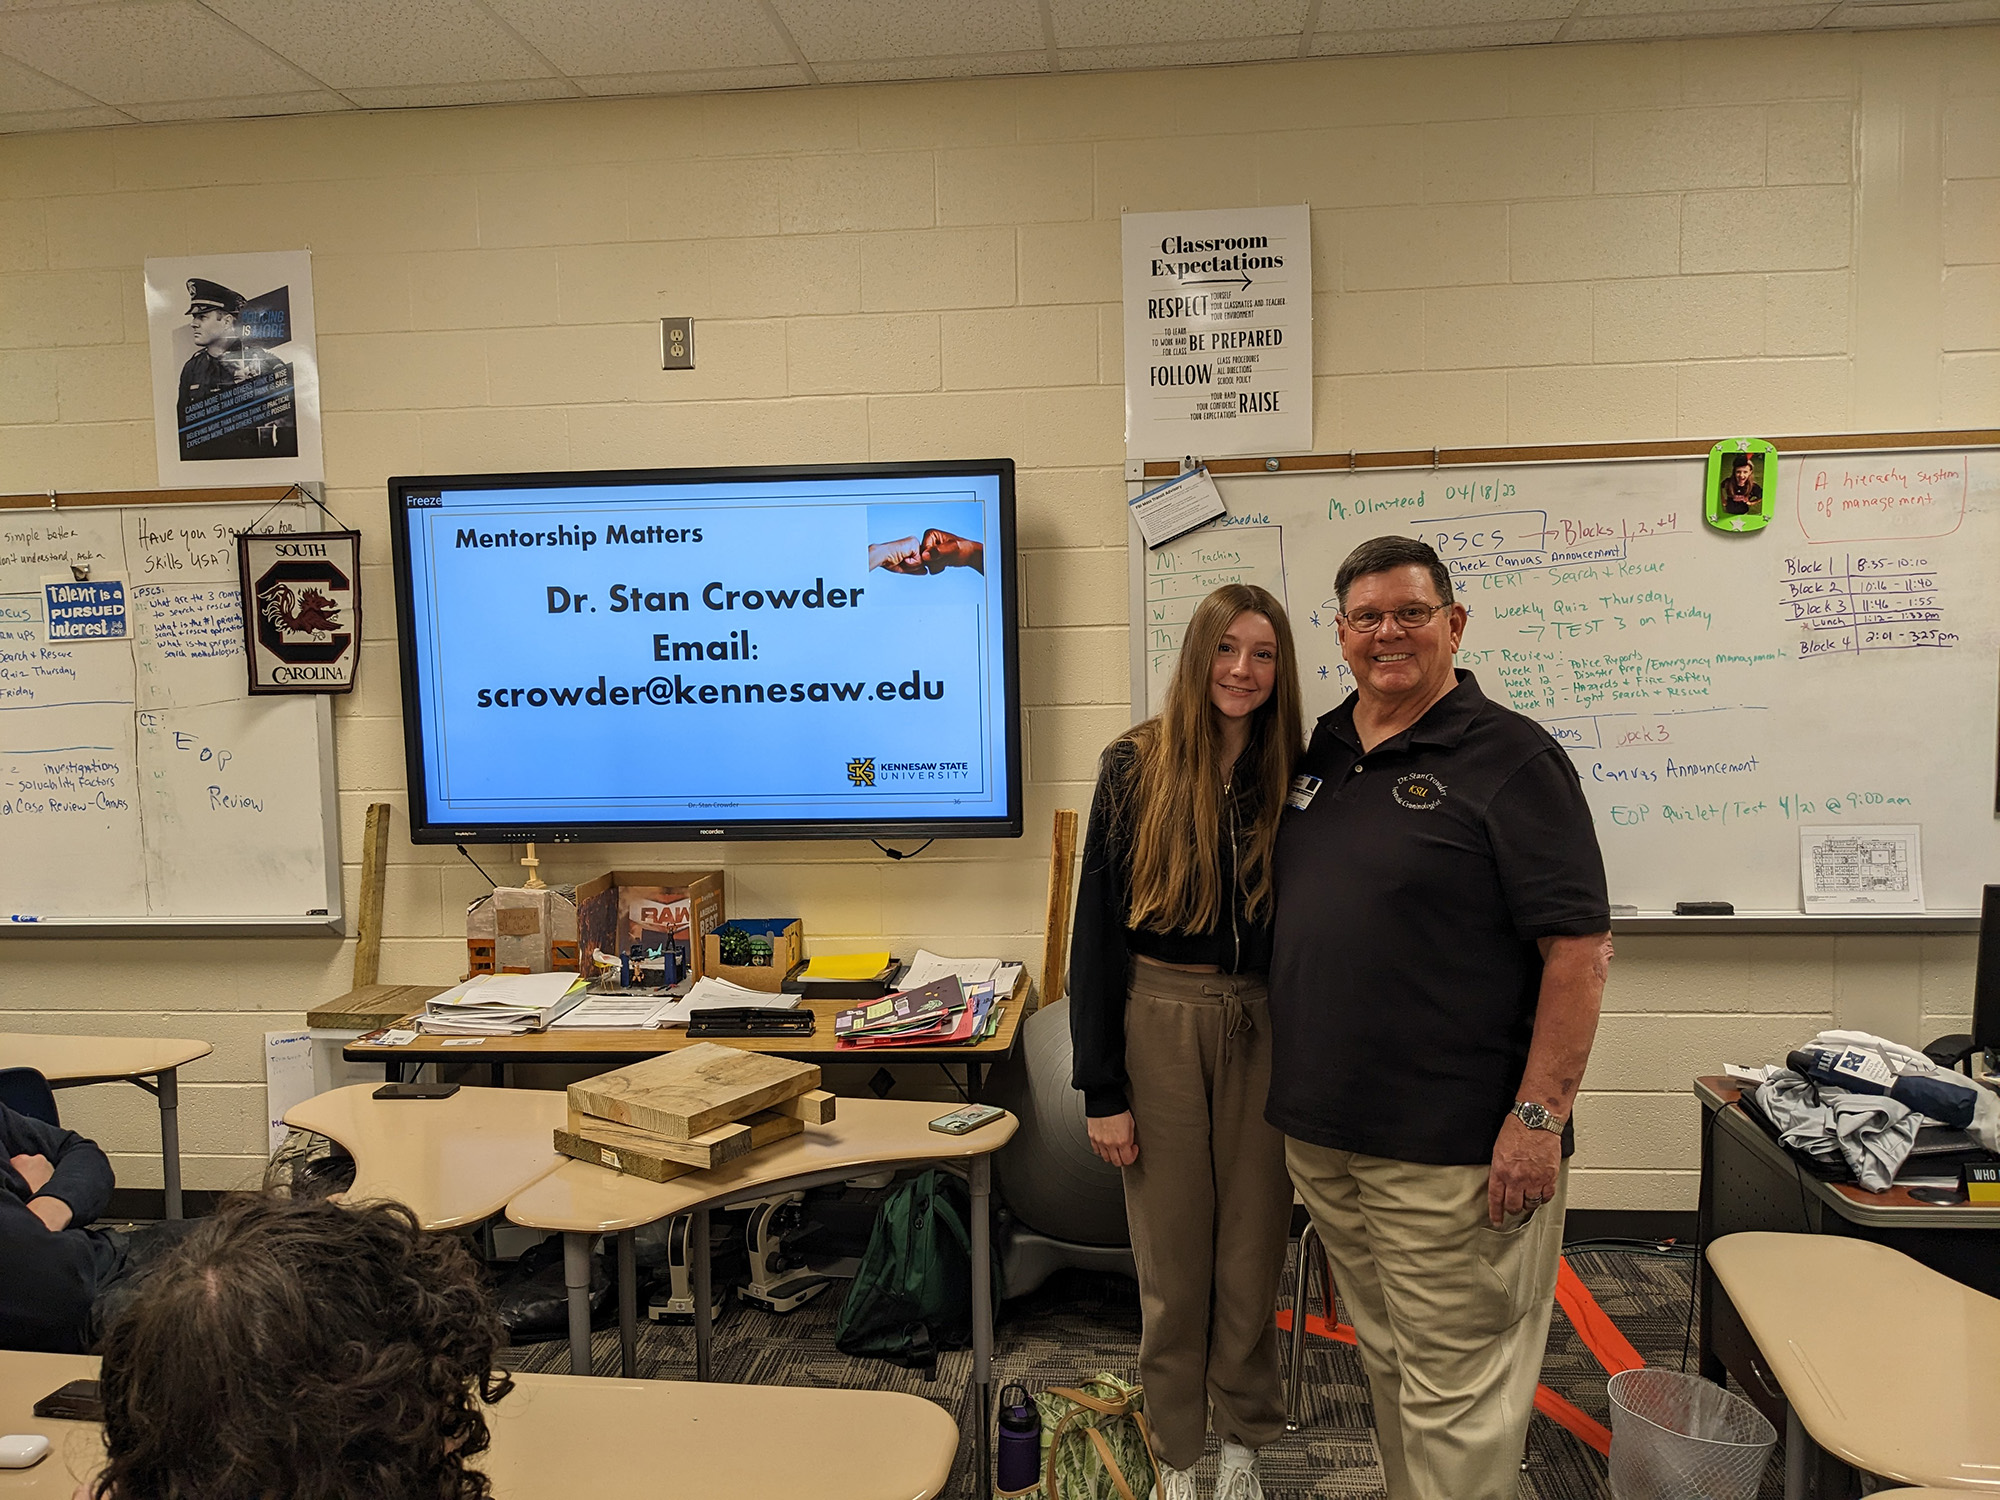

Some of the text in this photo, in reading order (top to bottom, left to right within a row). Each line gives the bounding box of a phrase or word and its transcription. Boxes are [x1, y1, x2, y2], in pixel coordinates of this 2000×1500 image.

[1161, 235, 1268, 255] Classroom
[1151, 252, 1283, 280] Expectations
[1210, 291, 1232, 301] YOURSELF
[1210, 297, 1286, 311] YOUR CLASSMATES AND TEACHER
[1148, 295, 1209, 319] RESPECT
[1210, 310, 1255, 321] YOUR ENVIRONMENT
[242, 323, 285, 338] IS MORE
[1164, 327, 1187, 336] TO LEARN
[1189, 328, 1283, 351] BE PREPARED
[1160, 338, 1174, 346] WORK
[1175, 337, 1187, 345] HARD
[1162, 347, 1187, 356] FOR CLASS
[1217, 354, 1260, 365] CLASS PROCEDURES
[1150, 363, 1213, 387] FOLLOW
[1217, 365, 1252, 375] ALL DIRECTIONS
[275, 378, 288, 388] SAFE
[1217, 375, 1251, 385] SCHOOL POLICY
[1210, 391, 1237, 400] YOUR HAND
[1239, 390, 1280, 414] RAISE
[1196, 401, 1237, 411] YOUR CONFIDENCE
[1190, 411, 1237, 421] YOUR EXPECTATIONS
[1814, 471, 1828, 492] A
[406, 495, 442, 507] Freeze
[1355, 490, 1426, 513] Olmstead
[1446, 478, 1516, 503] 04/18/23
[1817, 493, 1933, 518] of management
[1221, 513, 1271, 528] Schedule
[4, 528, 40, 546] simple
[180, 528, 207, 552] you
[455, 523, 704, 551] Mentorship Matters
[1560, 520, 1615, 546] Blocks
[275, 543, 327, 557] SOUTH
[1191, 548, 1241, 564] Teaching
[144, 549, 230, 573] Skills USA?
[1449, 552, 1543, 575] Check Canvas
[1785, 556, 1834, 576] Block 1
[1482, 560, 1665, 590] CERT Search Rescue
[47, 585, 122, 604] Talent a
[546, 577, 865, 614] Dr. Stan Crowder
[1789, 581, 1825, 597] Block
[1828, 581, 1845, 594] 2
[1904, 578, 1933, 592] 11:40
[150, 591, 215, 609] What the 3
[1495, 590, 1674, 622] Weekly Quiz Thursday
[51, 605, 125, 619] PURSUED
[153, 610, 165, 618] to
[1791, 601, 1832, 619] Block
[1836, 600, 1847, 614] 3
[50, 619, 109, 638] interest
[1551, 607, 1712, 640] TEST 3 on Friday
[1812, 618, 1846, 629] Lunch
[40, 648, 73, 660] Rescue
[653, 629, 758, 662] Email:
[1799, 636, 1851, 654] Block 4
[31, 665, 77, 681] Thursday
[272, 666, 344, 685] CAROLINA
[1498, 665, 1533, 677] Week
[477, 669, 945, 708] scrowder@kennesaw.edu
[1504, 678, 1531, 688] Week
[1539, 675, 1552, 685] 12
[1508, 689, 1535, 699] Week
[1542, 687, 1555, 697] 13
[1513, 699, 1541, 710] Week
[1612, 689, 1649, 701] Search
[1666, 686, 1710, 698] Rescue
[1656, 724, 1670, 743] 3
[880, 762, 968, 771] KENNESAW STATE
[1592, 754, 1761, 783] Canvas Announcement
[79, 776, 116, 789] Factors
[880, 771, 969, 781] UNIVERSITY
[207, 784, 264, 813] Review
[1408, 784, 1429, 798] KSU
[1610, 804, 1650, 826] EOP
[699, 828, 725, 836] recordex
[641, 906, 690, 923] RAW
[700, 913, 718, 937] BEST
[1973, 1168, 1997, 1181] WHO
